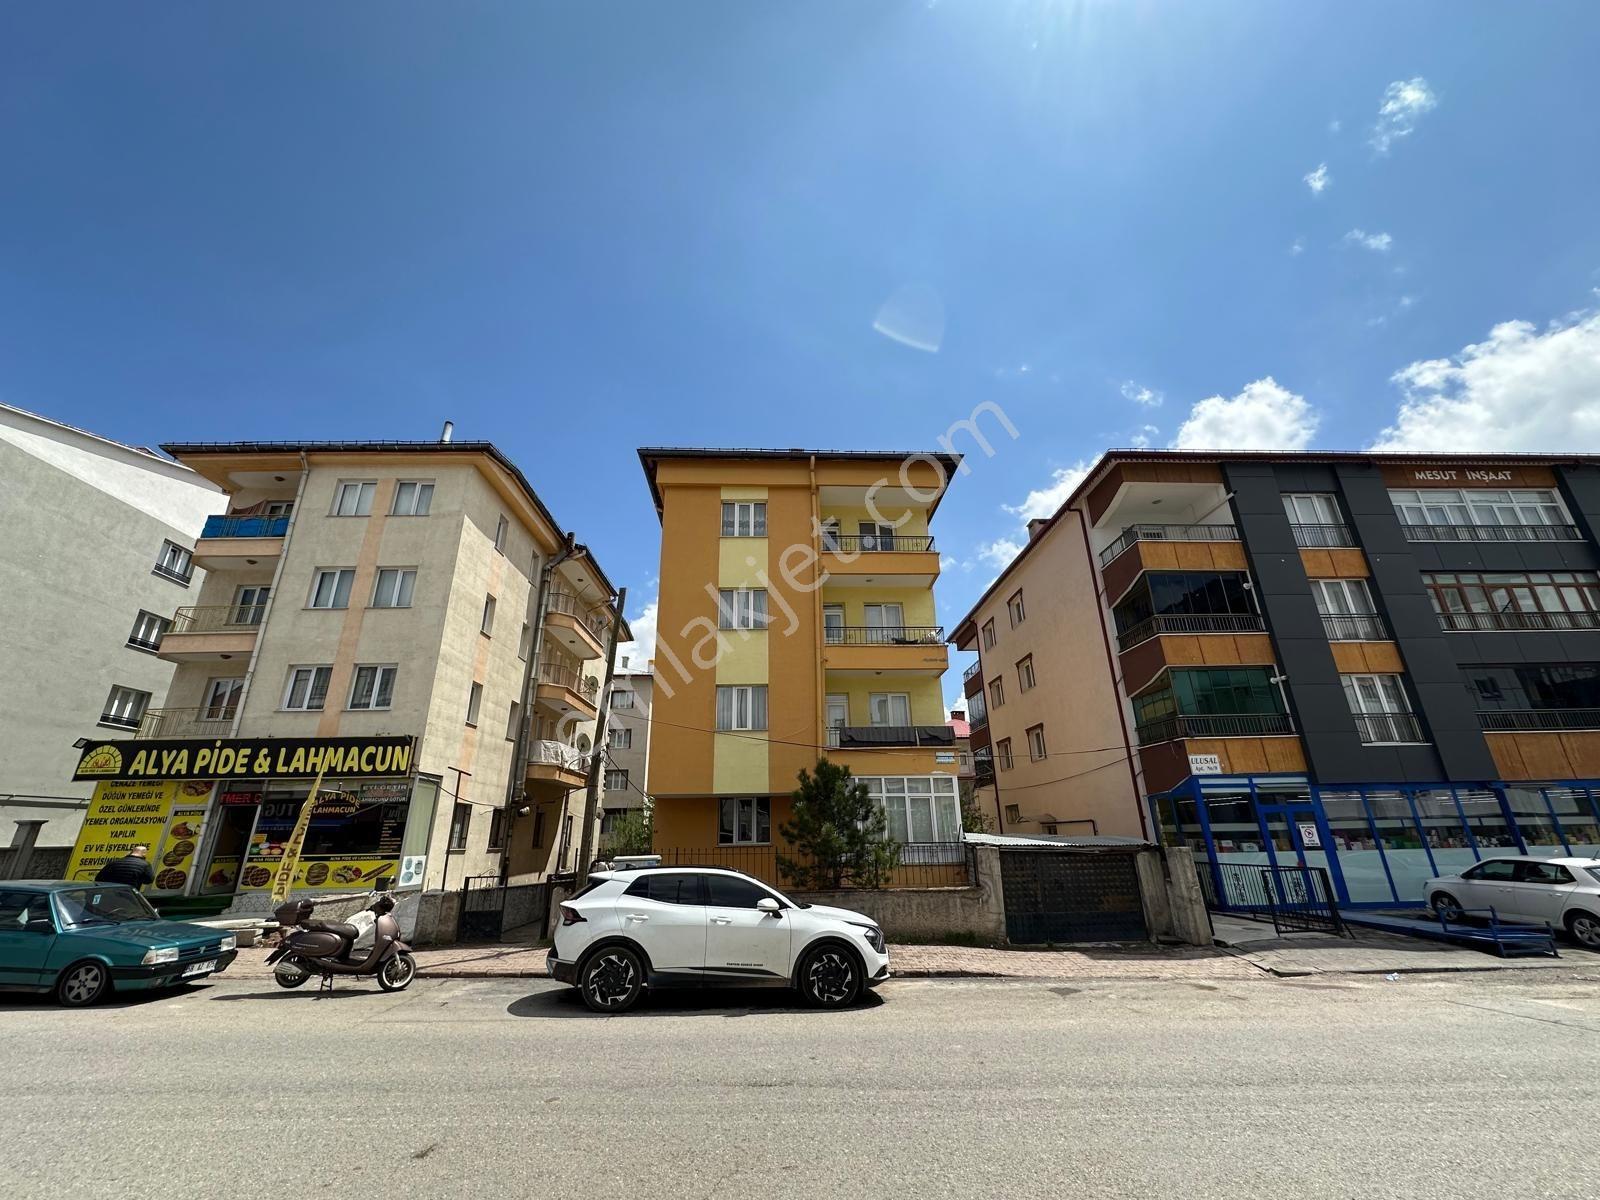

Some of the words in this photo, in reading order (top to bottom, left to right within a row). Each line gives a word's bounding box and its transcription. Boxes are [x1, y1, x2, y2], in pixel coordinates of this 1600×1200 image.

[1415, 471, 1457, 480] MESUT
[128, 749, 189, 775] ALYA
[193, 740, 252, 775] PİDE
[253, 748, 272, 774] &
[276, 745, 410, 773] LAHMACUN
[1190, 757, 1218, 765] ULUSAL
[312, 806, 356, 814] LAHMACUN
[85, 817, 108, 825] YEMEK
[110, 815, 168, 825] ORGANİZASYONU
[84, 844, 95, 852] EV
[95, 843, 105, 851] VE
